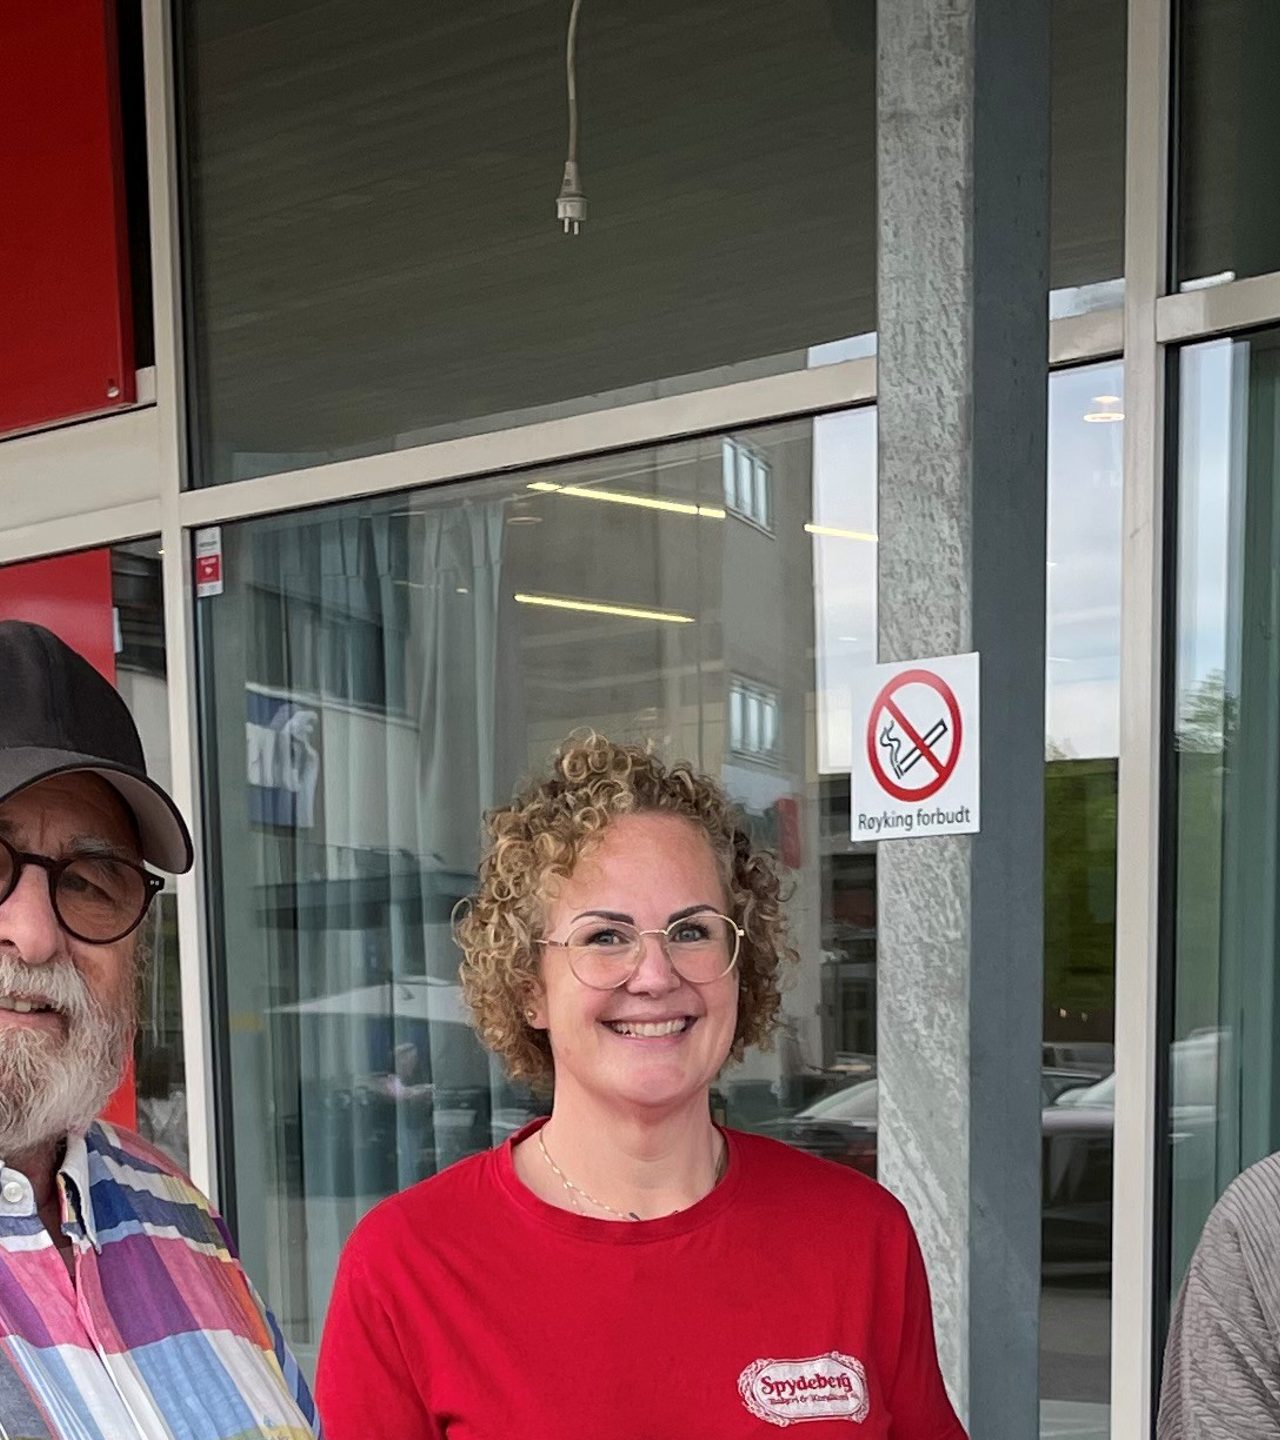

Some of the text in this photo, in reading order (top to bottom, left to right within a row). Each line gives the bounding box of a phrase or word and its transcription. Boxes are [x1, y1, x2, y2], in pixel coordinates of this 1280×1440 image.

[858, 806, 970, 833] Røyking forbudt
[760, 1373, 853, 1397] Spydeberg
